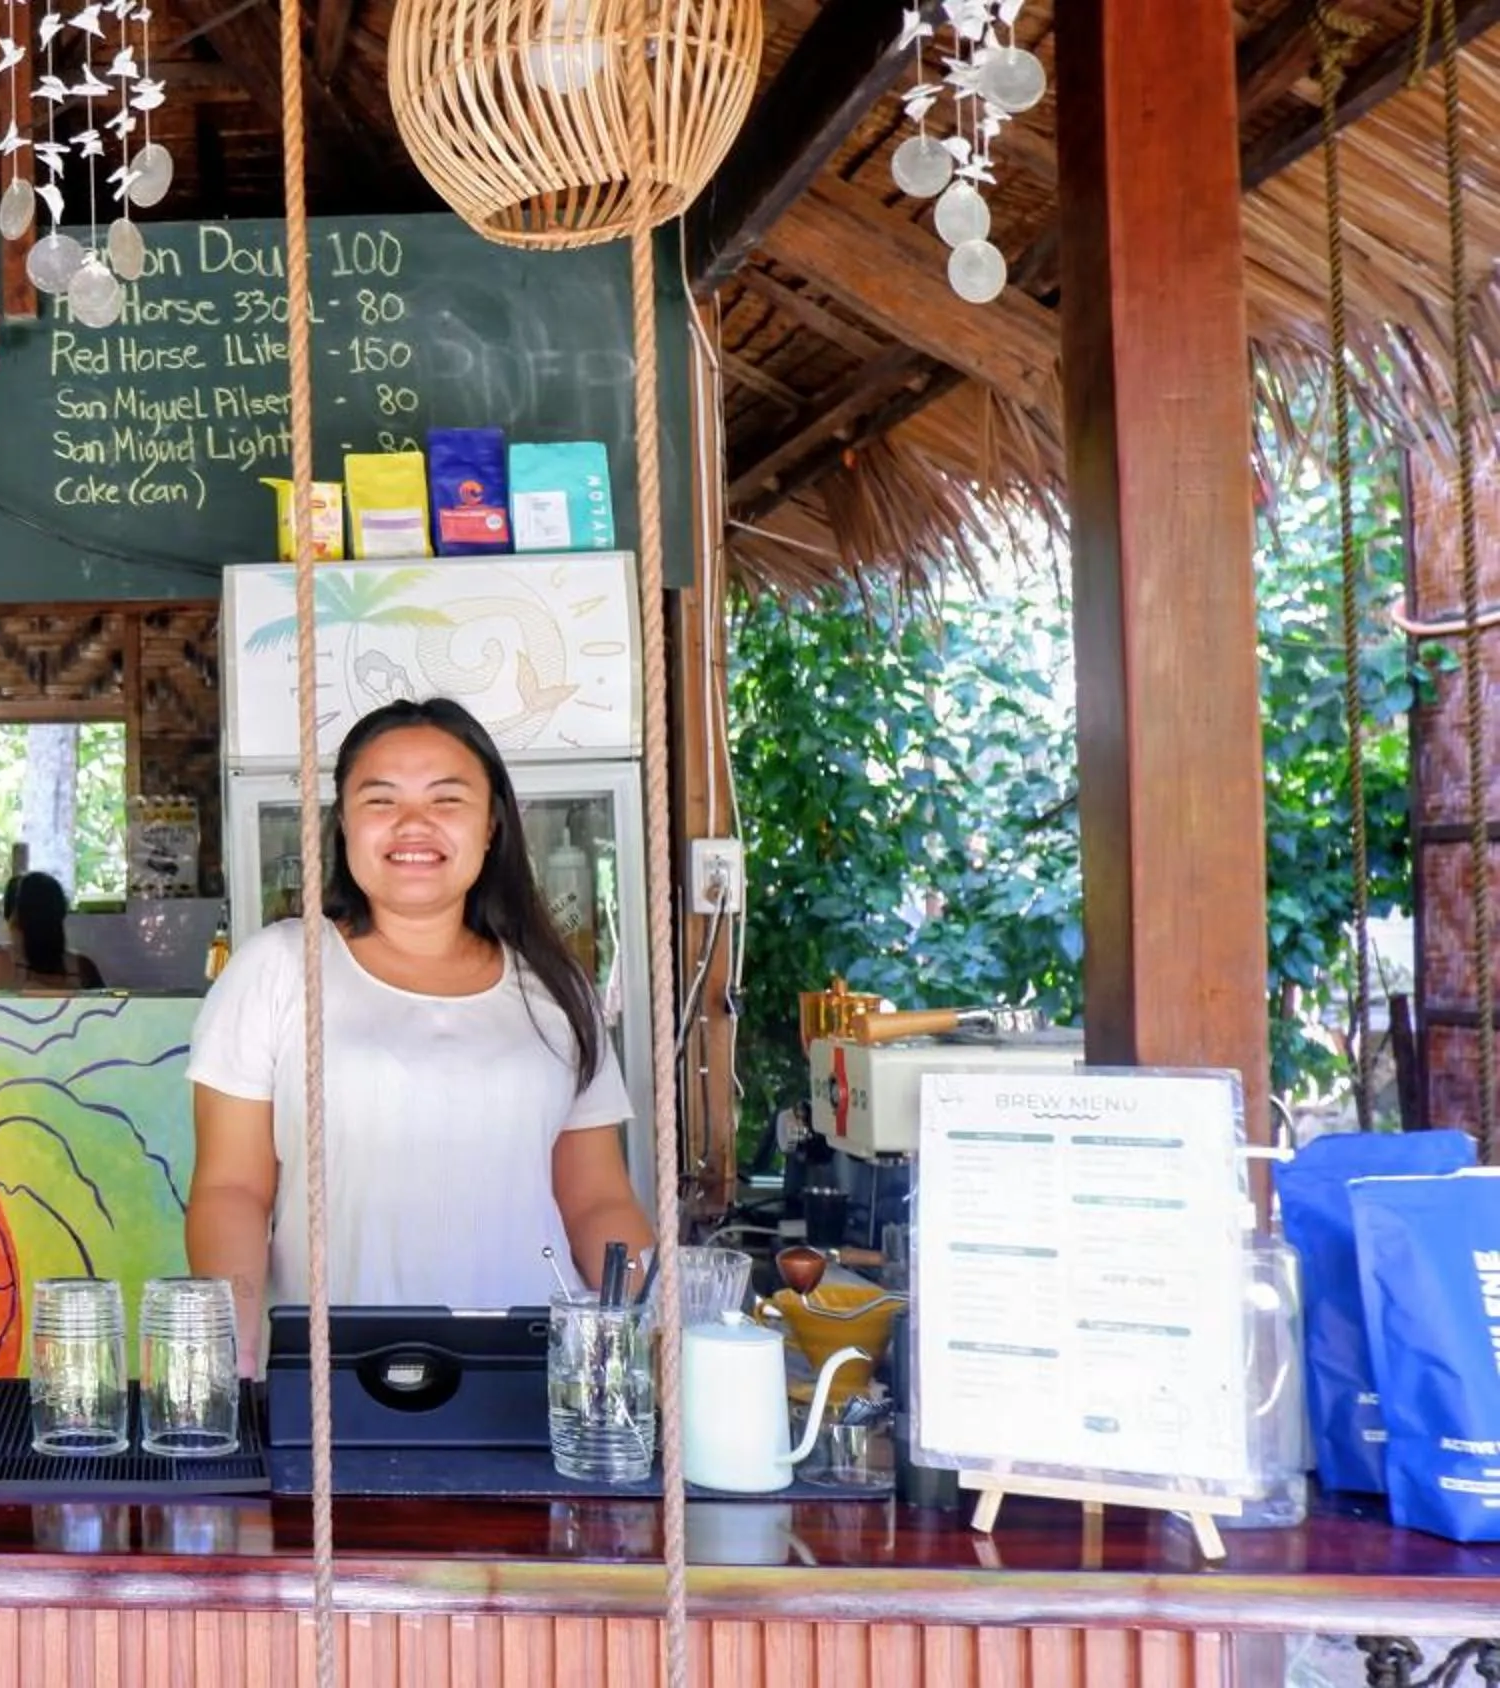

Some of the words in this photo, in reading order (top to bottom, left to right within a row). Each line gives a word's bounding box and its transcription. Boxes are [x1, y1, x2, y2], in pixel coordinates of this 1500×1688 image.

[330, 230, 402, 278] 100
[120, 282, 221, 326] Horse
[357, 289, 405, 325] 80
[51, 331, 111, 376] Red
[119, 336, 206, 373] Horse
[224, 332, 291, 367] 1Lite
[348, 336, 412, 374] 150
[56, 387, 107, 421] San
[376, 383, 418, 415] 80
[53, 431, 106, 464] San
[206, 421, 294, 472] Light
[55, 474, 122, 506] Coke
[128, 466, 206, 510] (can)
[995, 1092, 1063, 1111] BREW
[1069, 1094, 1139, 1113] MENU
